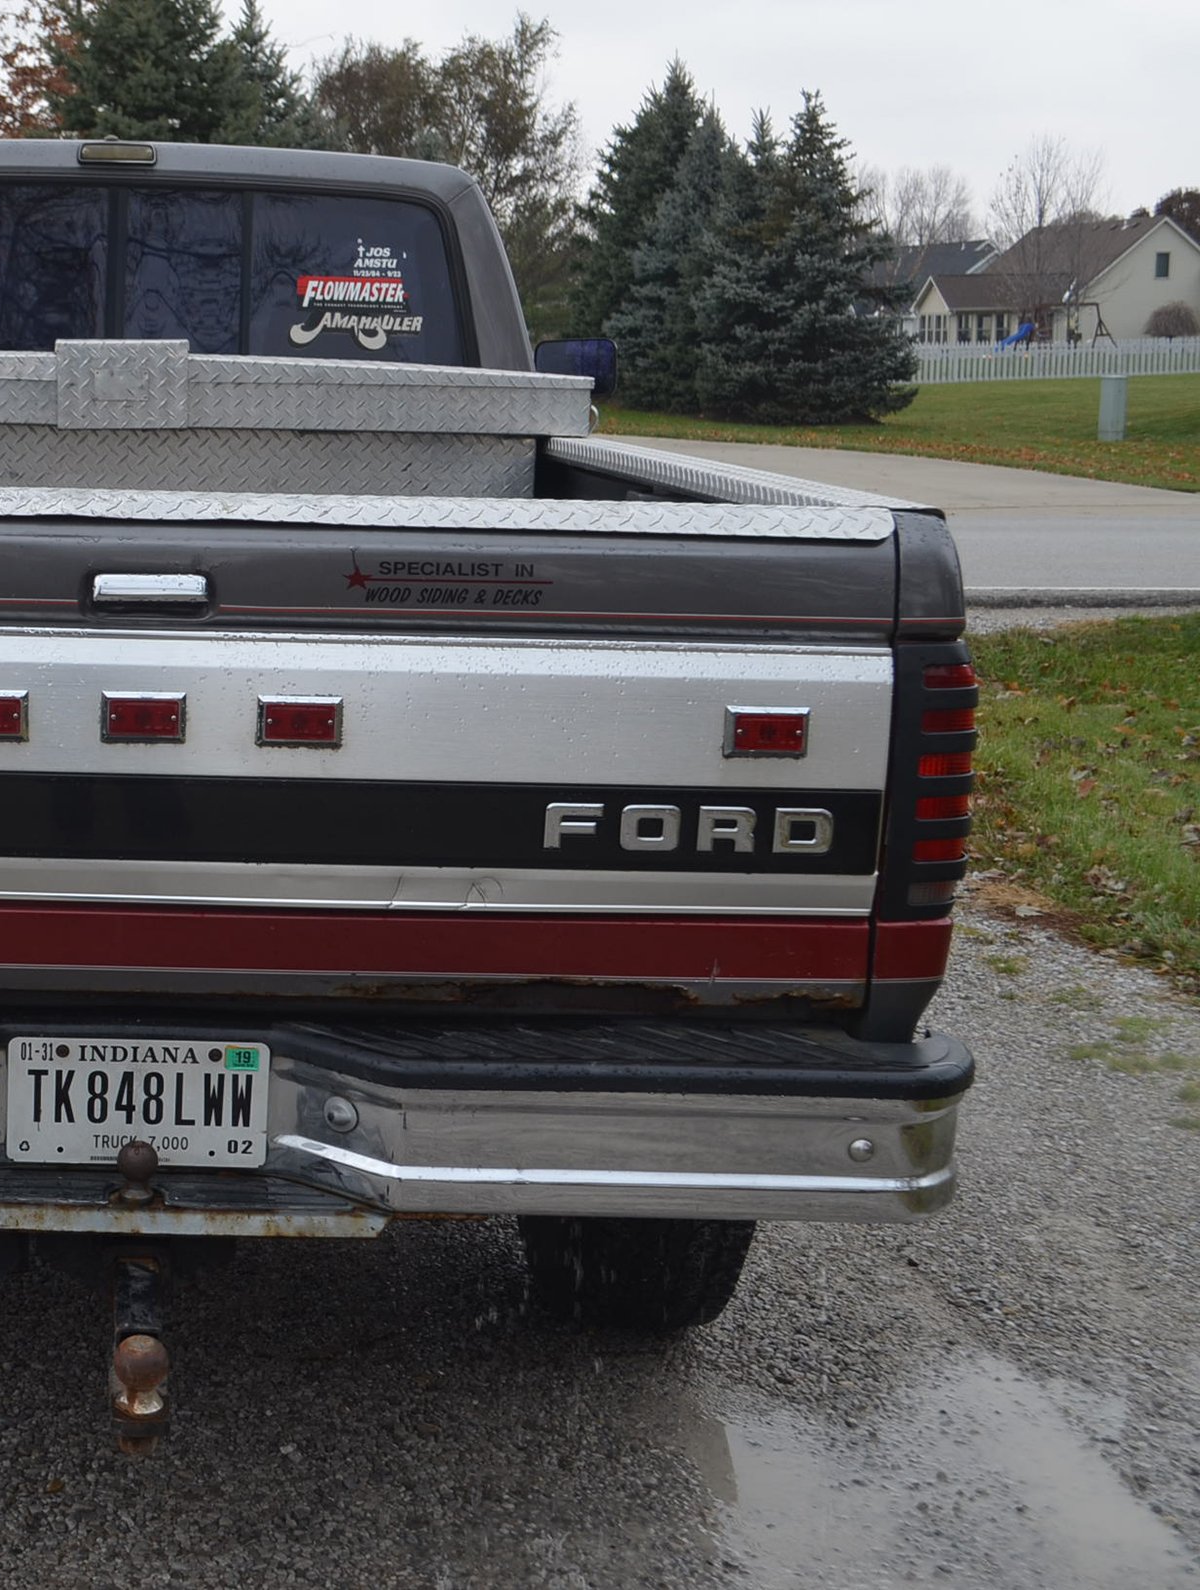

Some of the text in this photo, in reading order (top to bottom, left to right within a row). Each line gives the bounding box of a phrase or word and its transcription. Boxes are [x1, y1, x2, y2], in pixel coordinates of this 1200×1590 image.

[302, 280, 404, 307] FLOWMASTER
[378, 561, 534, 577] SPECIALIST IN
[364, 587, 543, 605] WOOD SIDING & DECKS
[543, 802, 834, 854] FORD
[20, 1042, 54, 1061] 01-31
[78, 1044, 199, 1065] INDIANA
[235, 1051, 251, 1064] 19
[147, 1136, 189, 1151] 7,000
[227, 1139, 253, 1155] 02
